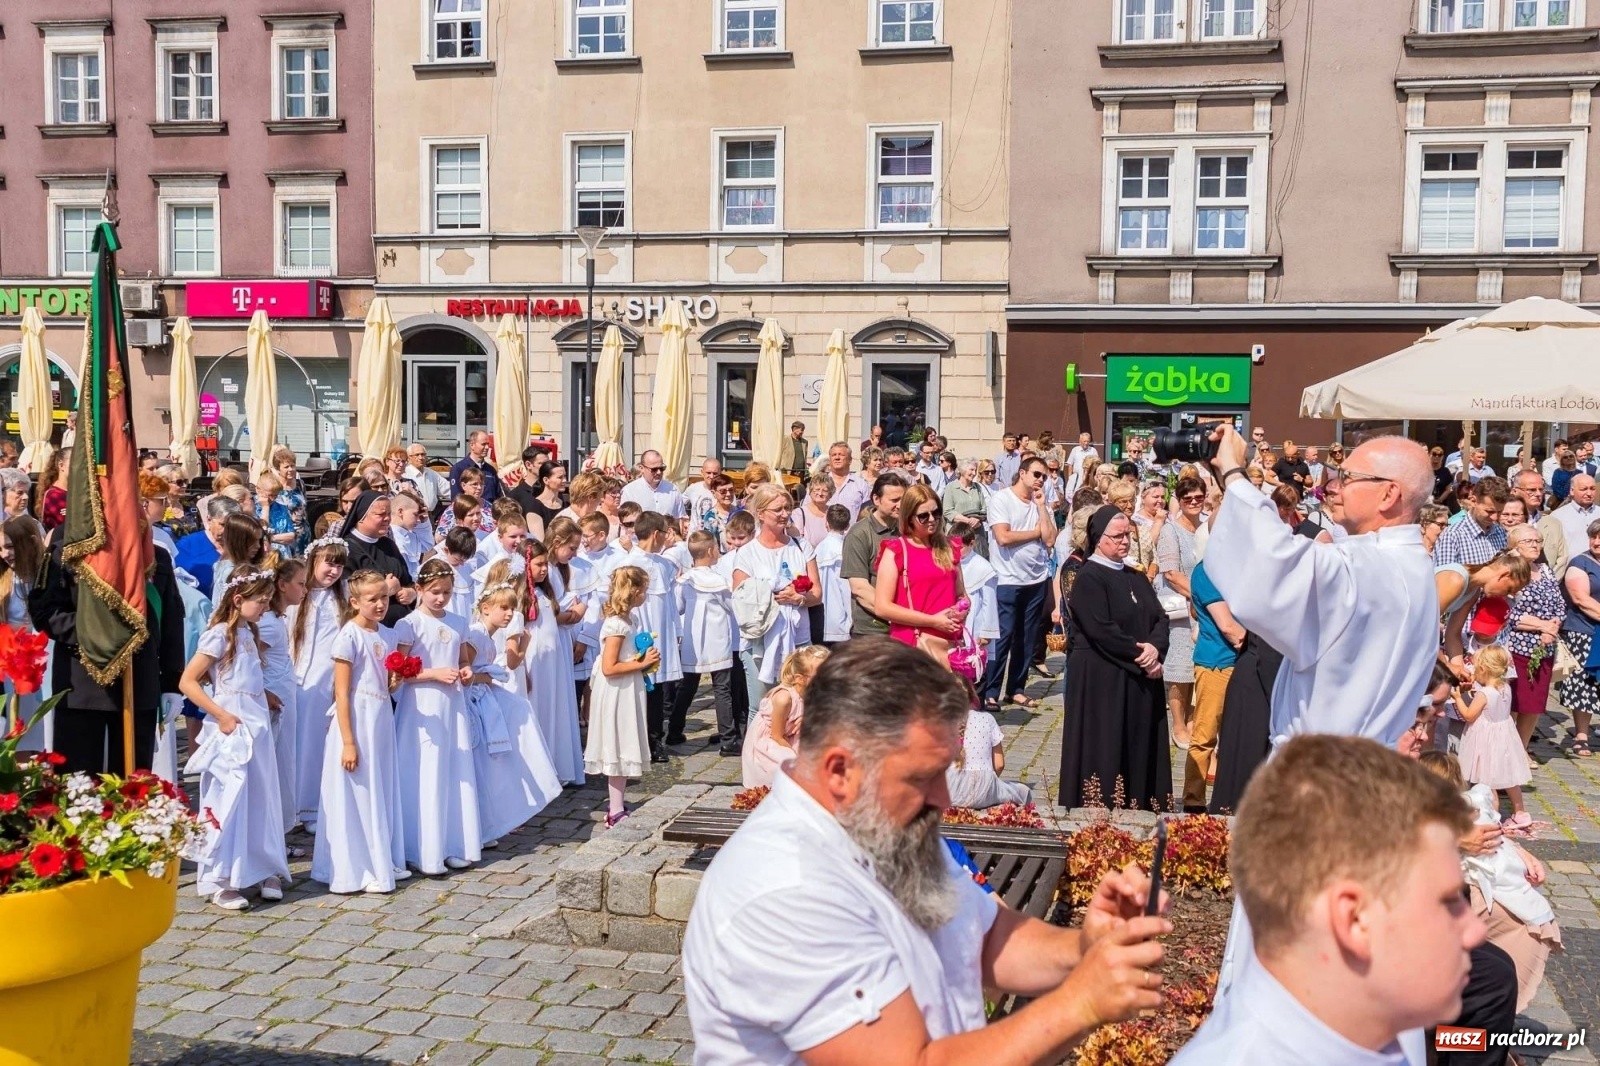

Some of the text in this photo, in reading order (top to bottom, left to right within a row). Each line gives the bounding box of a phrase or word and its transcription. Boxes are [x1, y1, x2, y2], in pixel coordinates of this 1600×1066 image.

[447, 295, 717, 321] RESTAURACJA SHRO
[1126, 365, 1230, 393] żabka
[1471, 394, 1557, 409] Manufaktura
